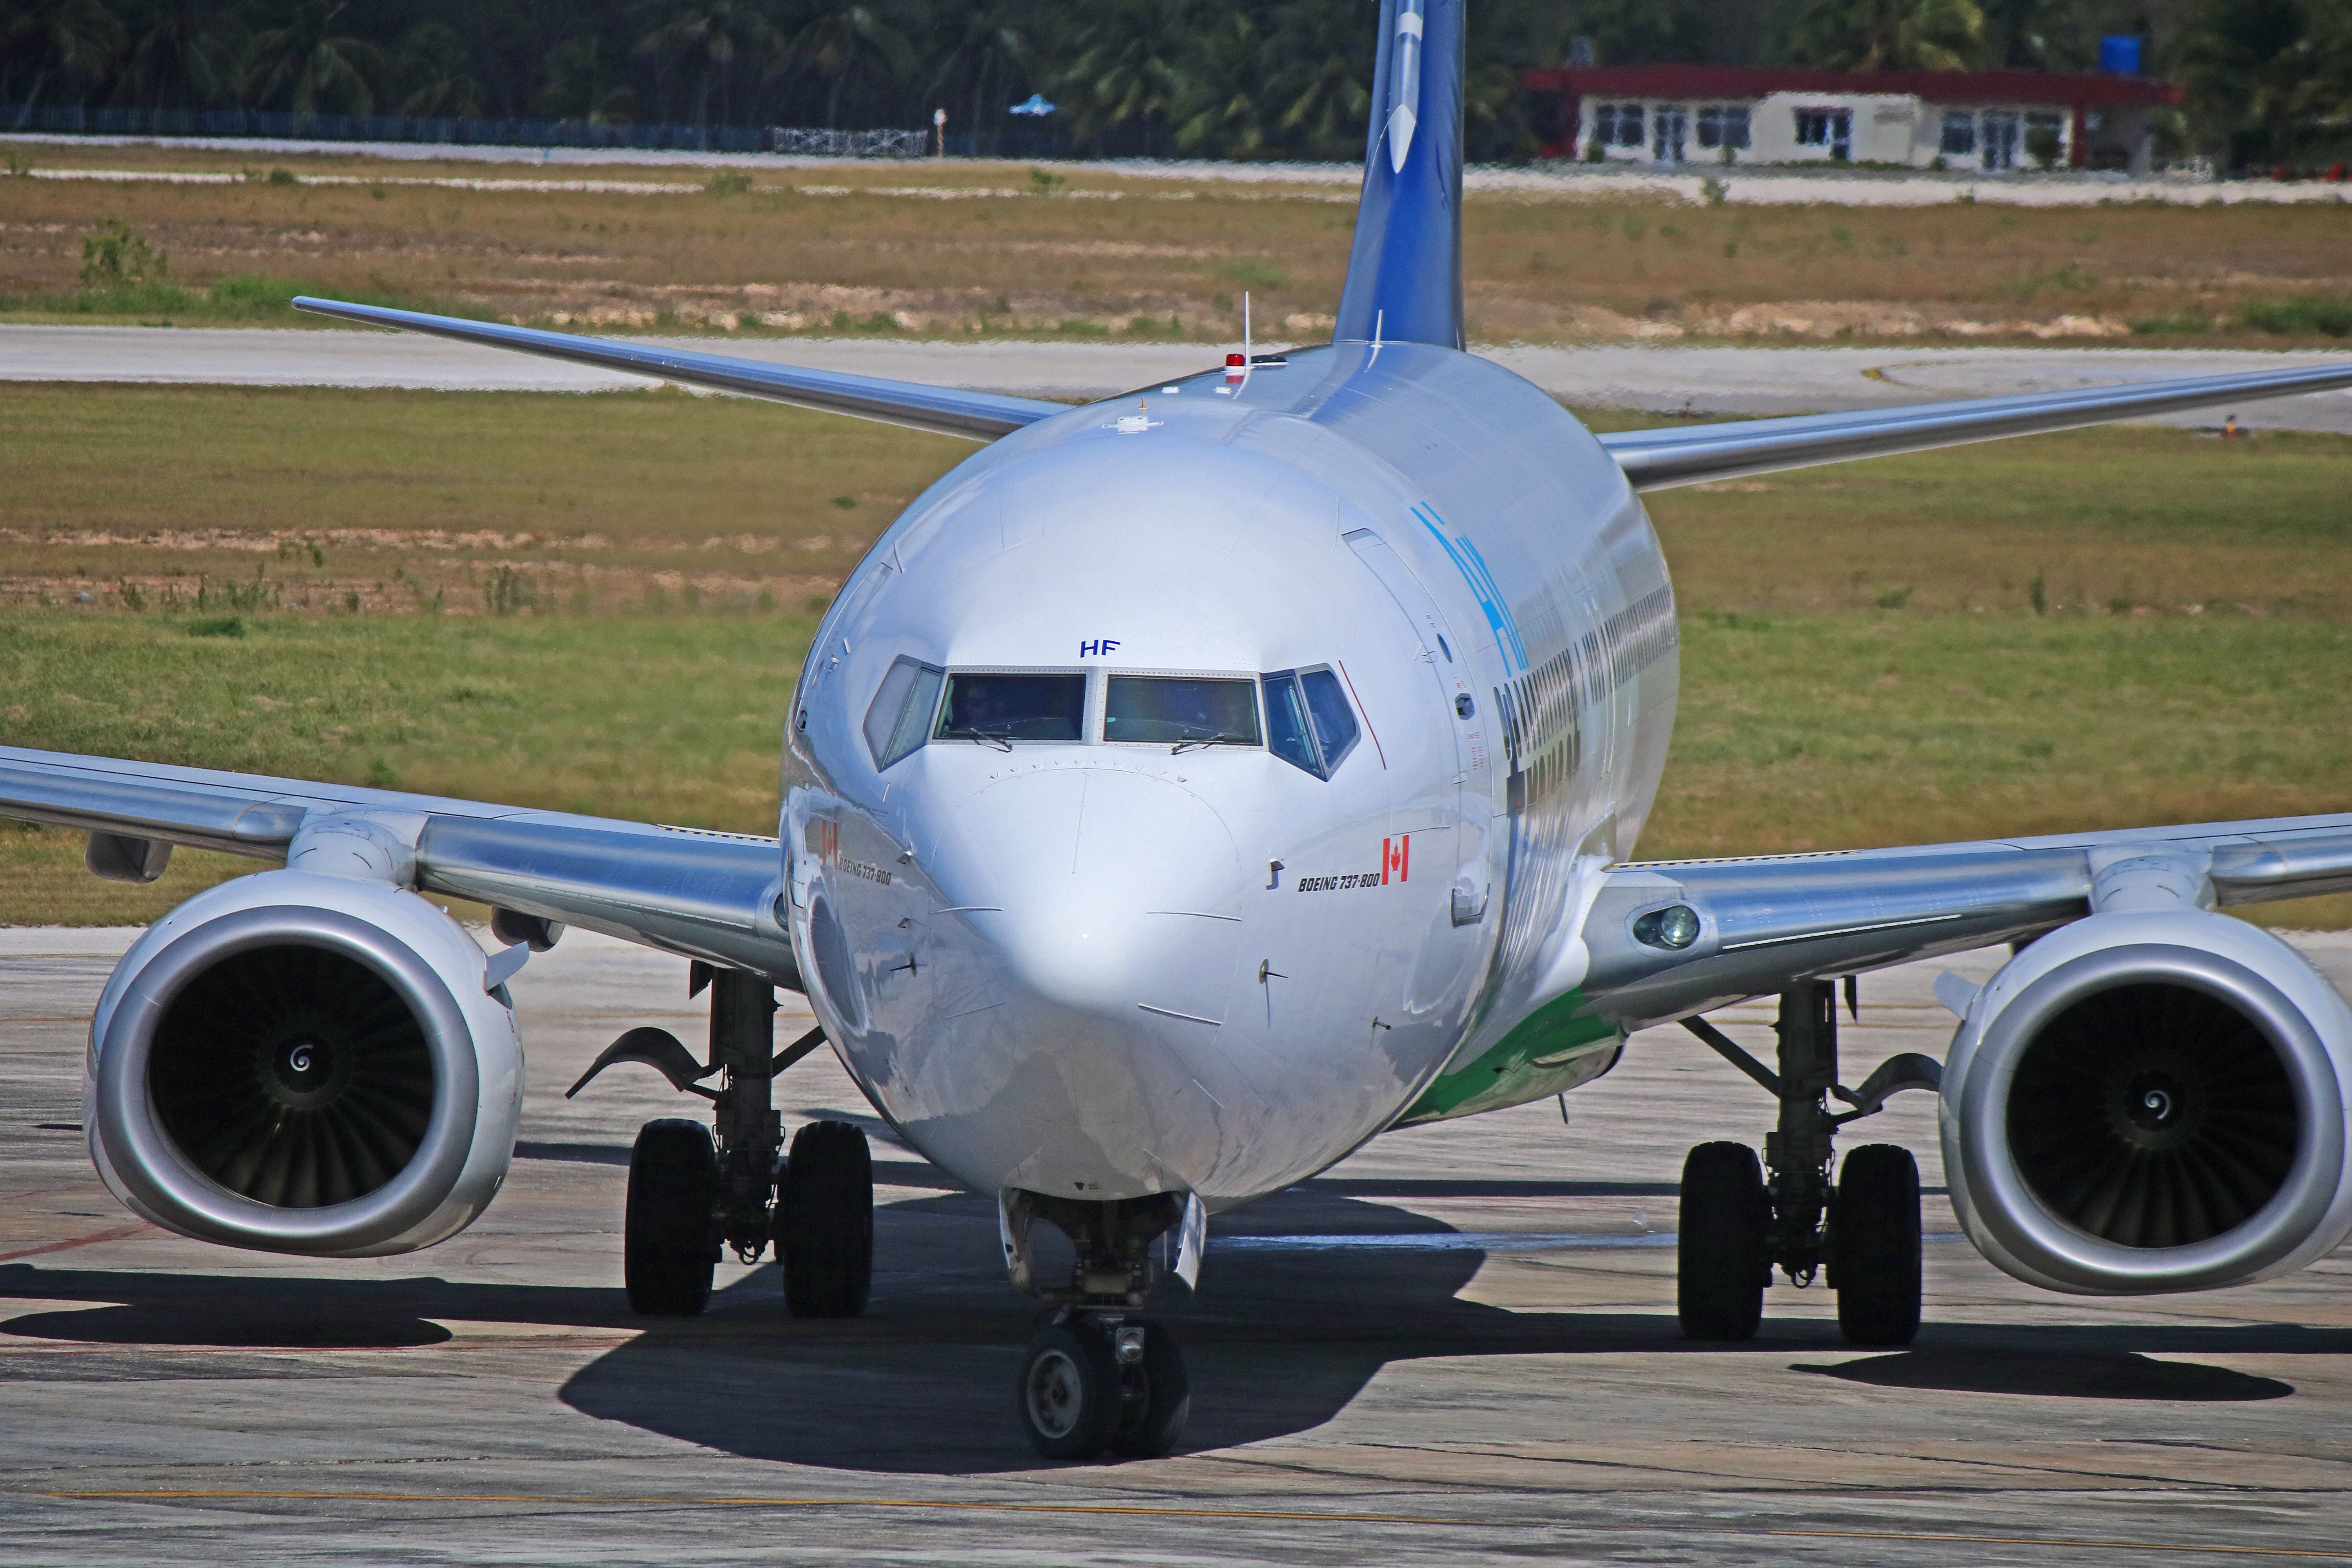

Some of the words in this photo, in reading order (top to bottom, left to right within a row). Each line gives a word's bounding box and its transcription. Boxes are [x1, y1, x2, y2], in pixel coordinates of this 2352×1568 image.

[1080, 639, 1121, 658] HF
[839, 857, 862, 877] BOEING
[862, 865, 891, 886] 737-800
[1298, 876, 1338, 892] BOEING
[1339, 873, 1380, 889] 737-800
